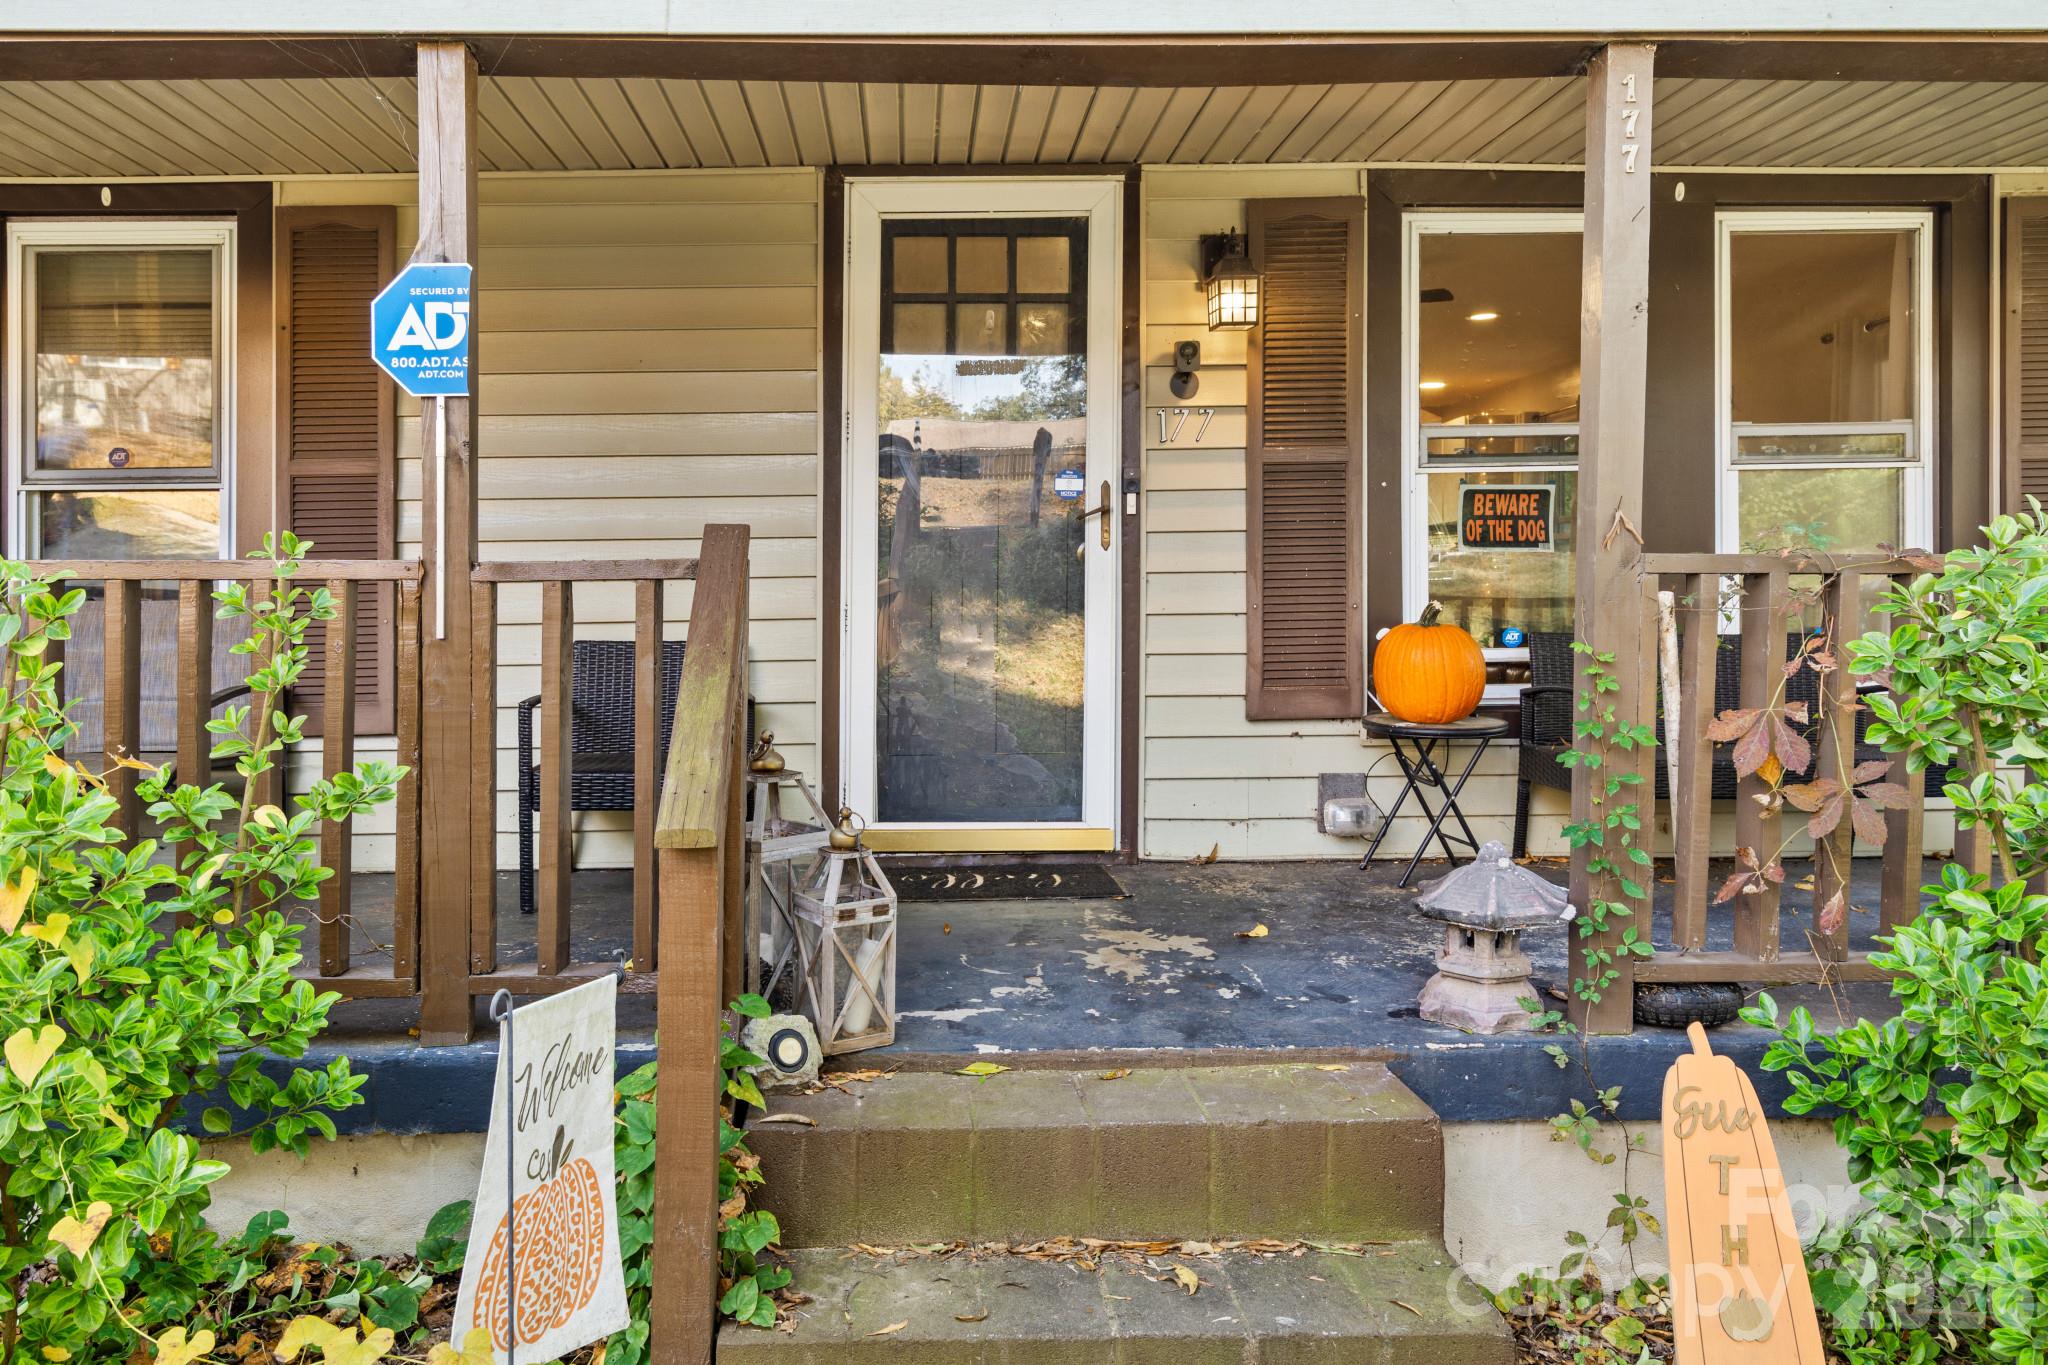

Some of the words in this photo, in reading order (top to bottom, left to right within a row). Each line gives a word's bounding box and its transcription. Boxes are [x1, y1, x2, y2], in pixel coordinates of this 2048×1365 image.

[1621, 73, 1640, 173] 177
[409, 287, 454, 295] SECURED
[457, 287, 468, 295] BY
[418, 370, 464, 379] ADT.COM
[1157, 407, 1215, 443] 177
[1473, 493, 1540, 516] BEWARE
[1466, 519, 1484, 542] OF
[1487, 519, 1514, 542] THE
[1518, 519, 1546, 542] DOG
[1505, 632, 1520, 641] ADT
[515, 1033, 609, 1133] Welcome
